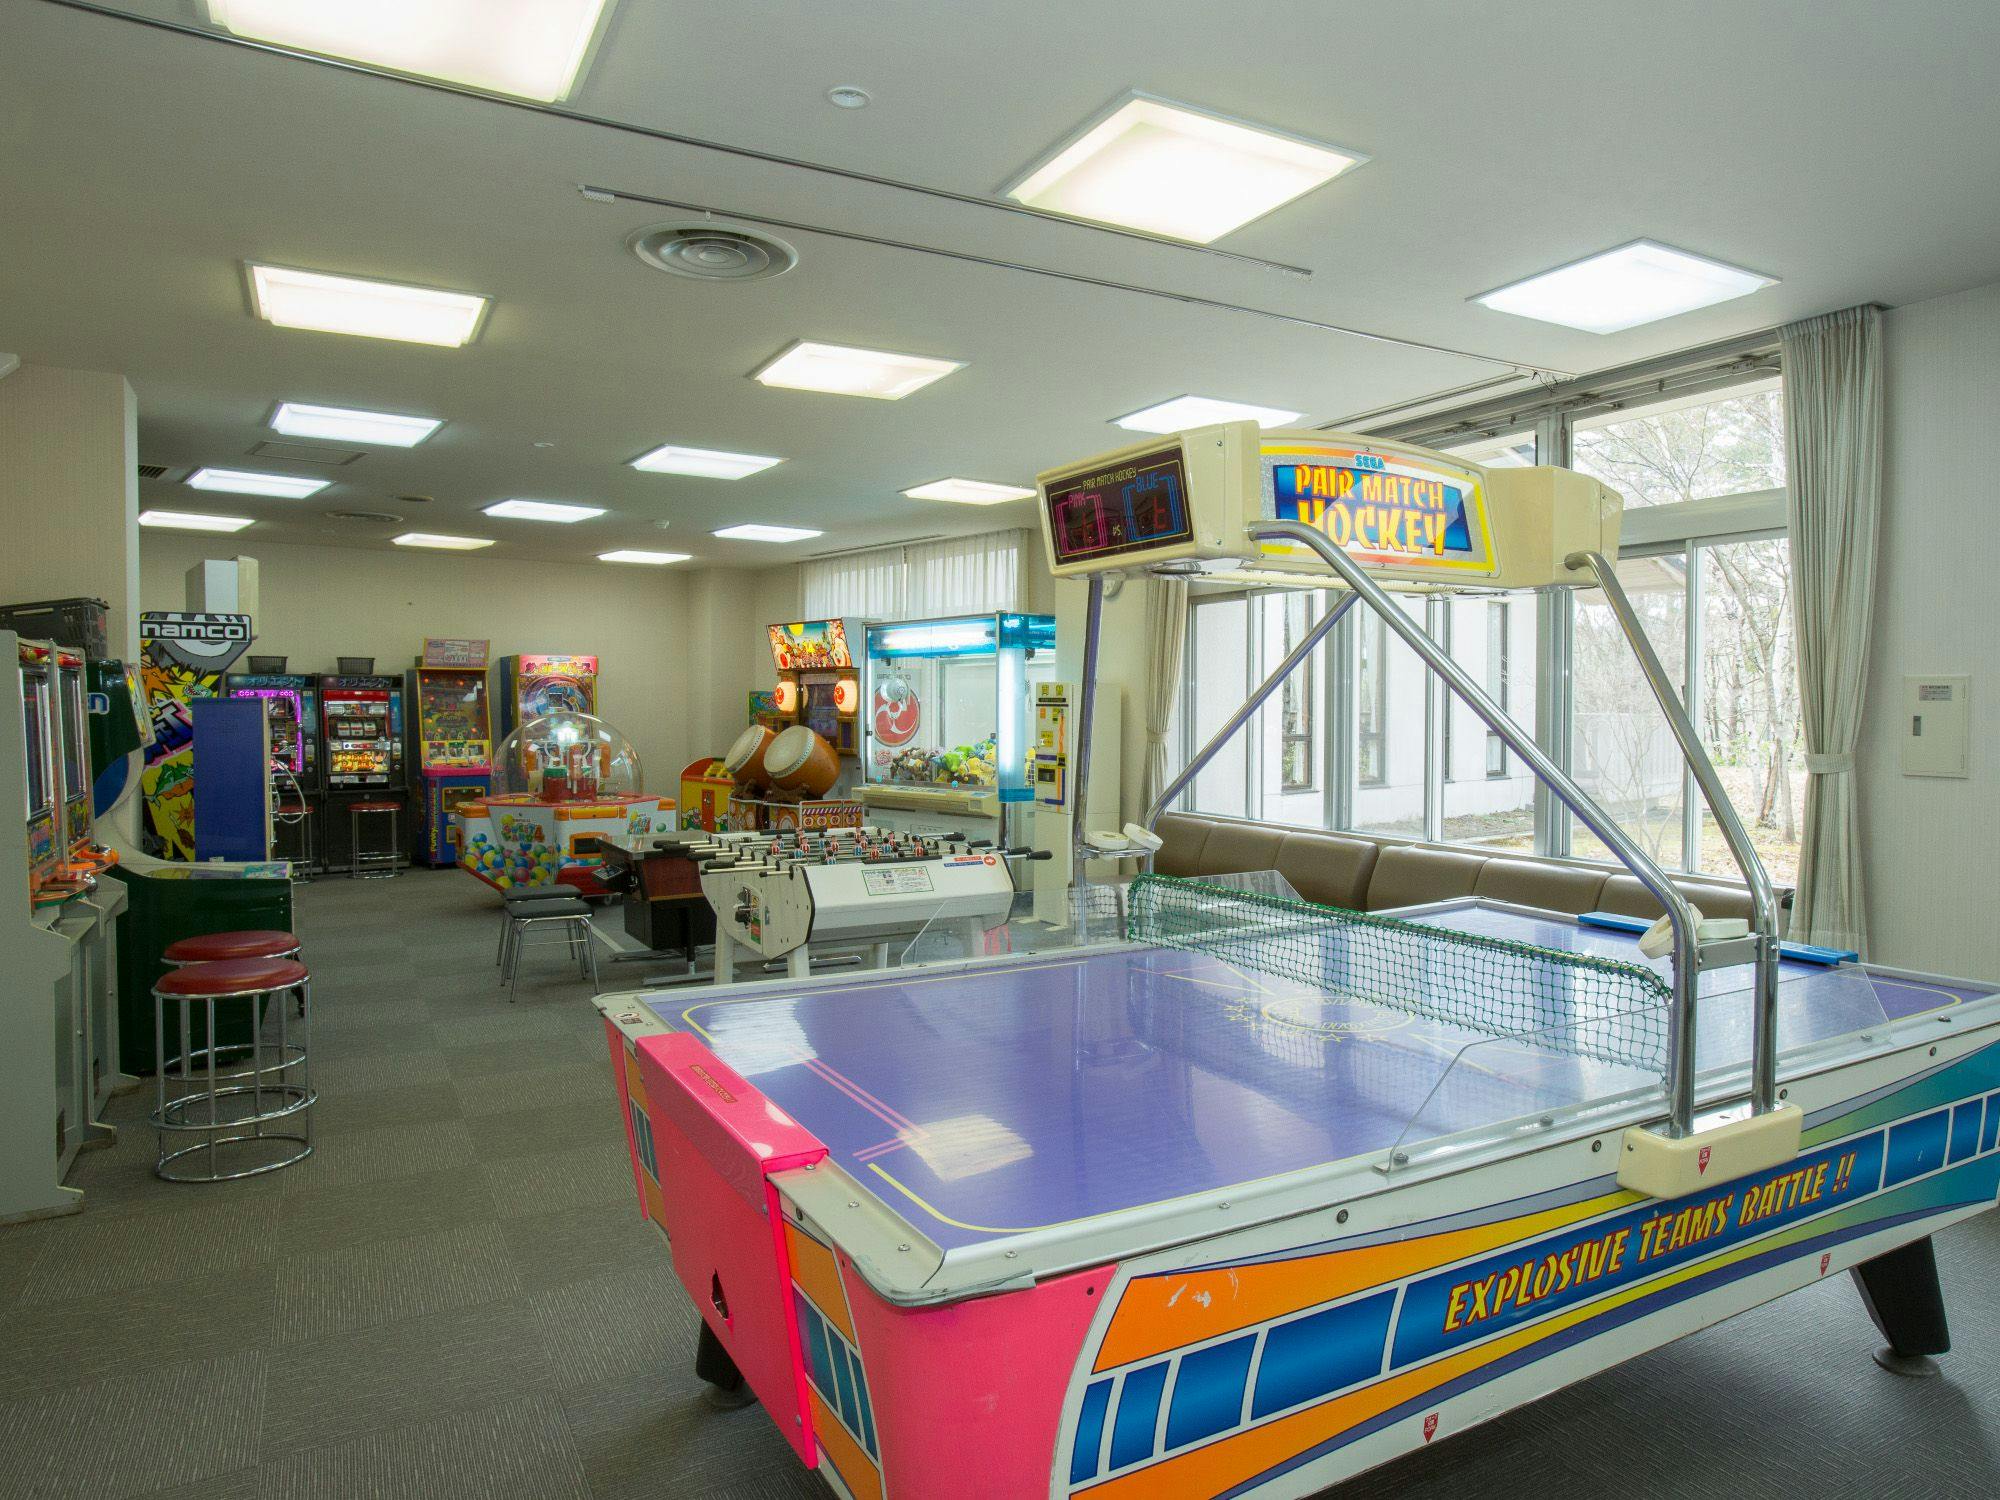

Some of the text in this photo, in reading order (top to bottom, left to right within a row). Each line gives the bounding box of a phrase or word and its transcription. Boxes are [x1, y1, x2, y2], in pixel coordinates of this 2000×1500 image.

[1354, 454, 1385, 469] SEGA
[1083, 467, 1136, 491] PAIR MATCH HOCKEY
[1136, 472, 1159, 492] BLUE
[1295, 464, 1444, 509] PAIR MATCH
[1068, 492, 1087, 508] PINK
[1298, 498, 1446, 555] HOCKEY
[142, 623, 244, 640] namco
[1443, 1226, 1631, 1334] EXPLOSIVE
[1738, 1161, 1829, 1227] BATTLE
